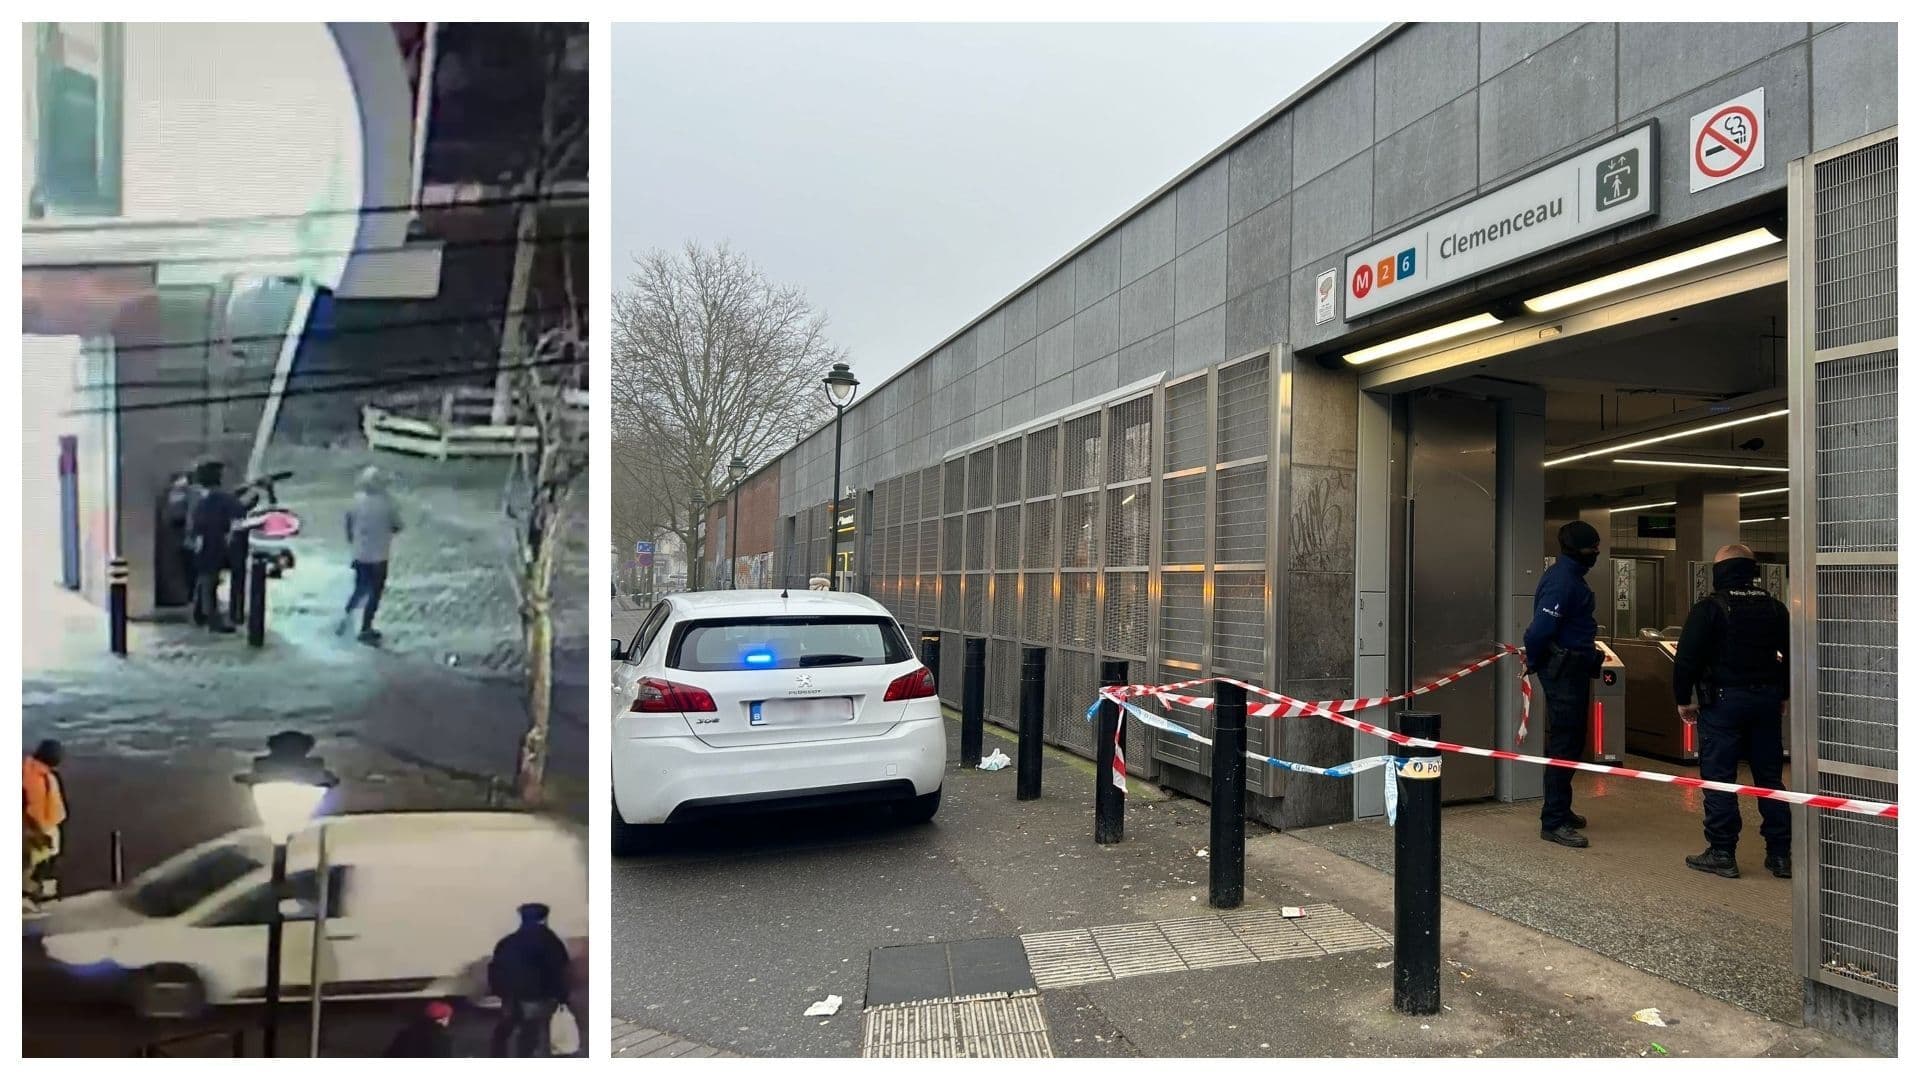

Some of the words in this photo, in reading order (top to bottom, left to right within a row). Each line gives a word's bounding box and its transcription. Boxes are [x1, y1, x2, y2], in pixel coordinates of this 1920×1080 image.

[1356, 271, 1369, 294] M
[1382, 264, 1390, 280] 2
[1402, 255, 1410, 272] 6
[1439, 197, 1563, 260] Clemenceau
[753, 712, 761, 720] B
